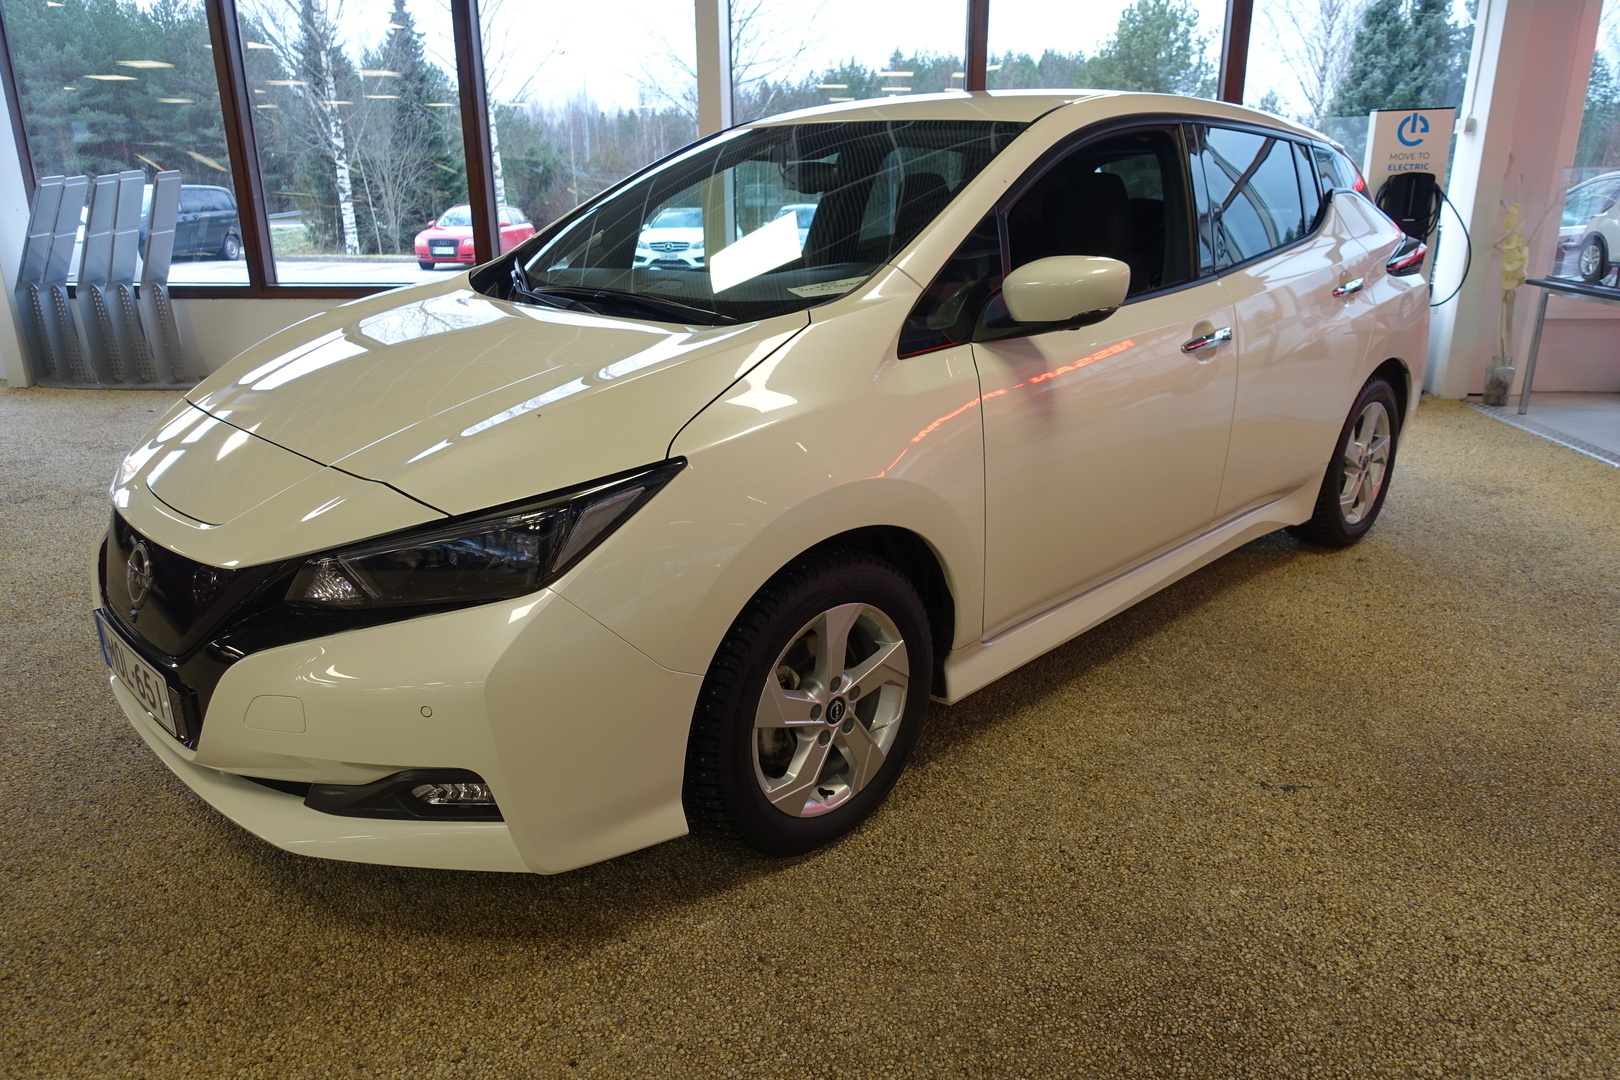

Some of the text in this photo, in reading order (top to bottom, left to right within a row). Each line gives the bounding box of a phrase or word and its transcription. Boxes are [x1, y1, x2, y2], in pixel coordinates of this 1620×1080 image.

[1389, 152, 1431, 161] MOVE TO
[1387, 163, 1430, 171] ELECTRIC
